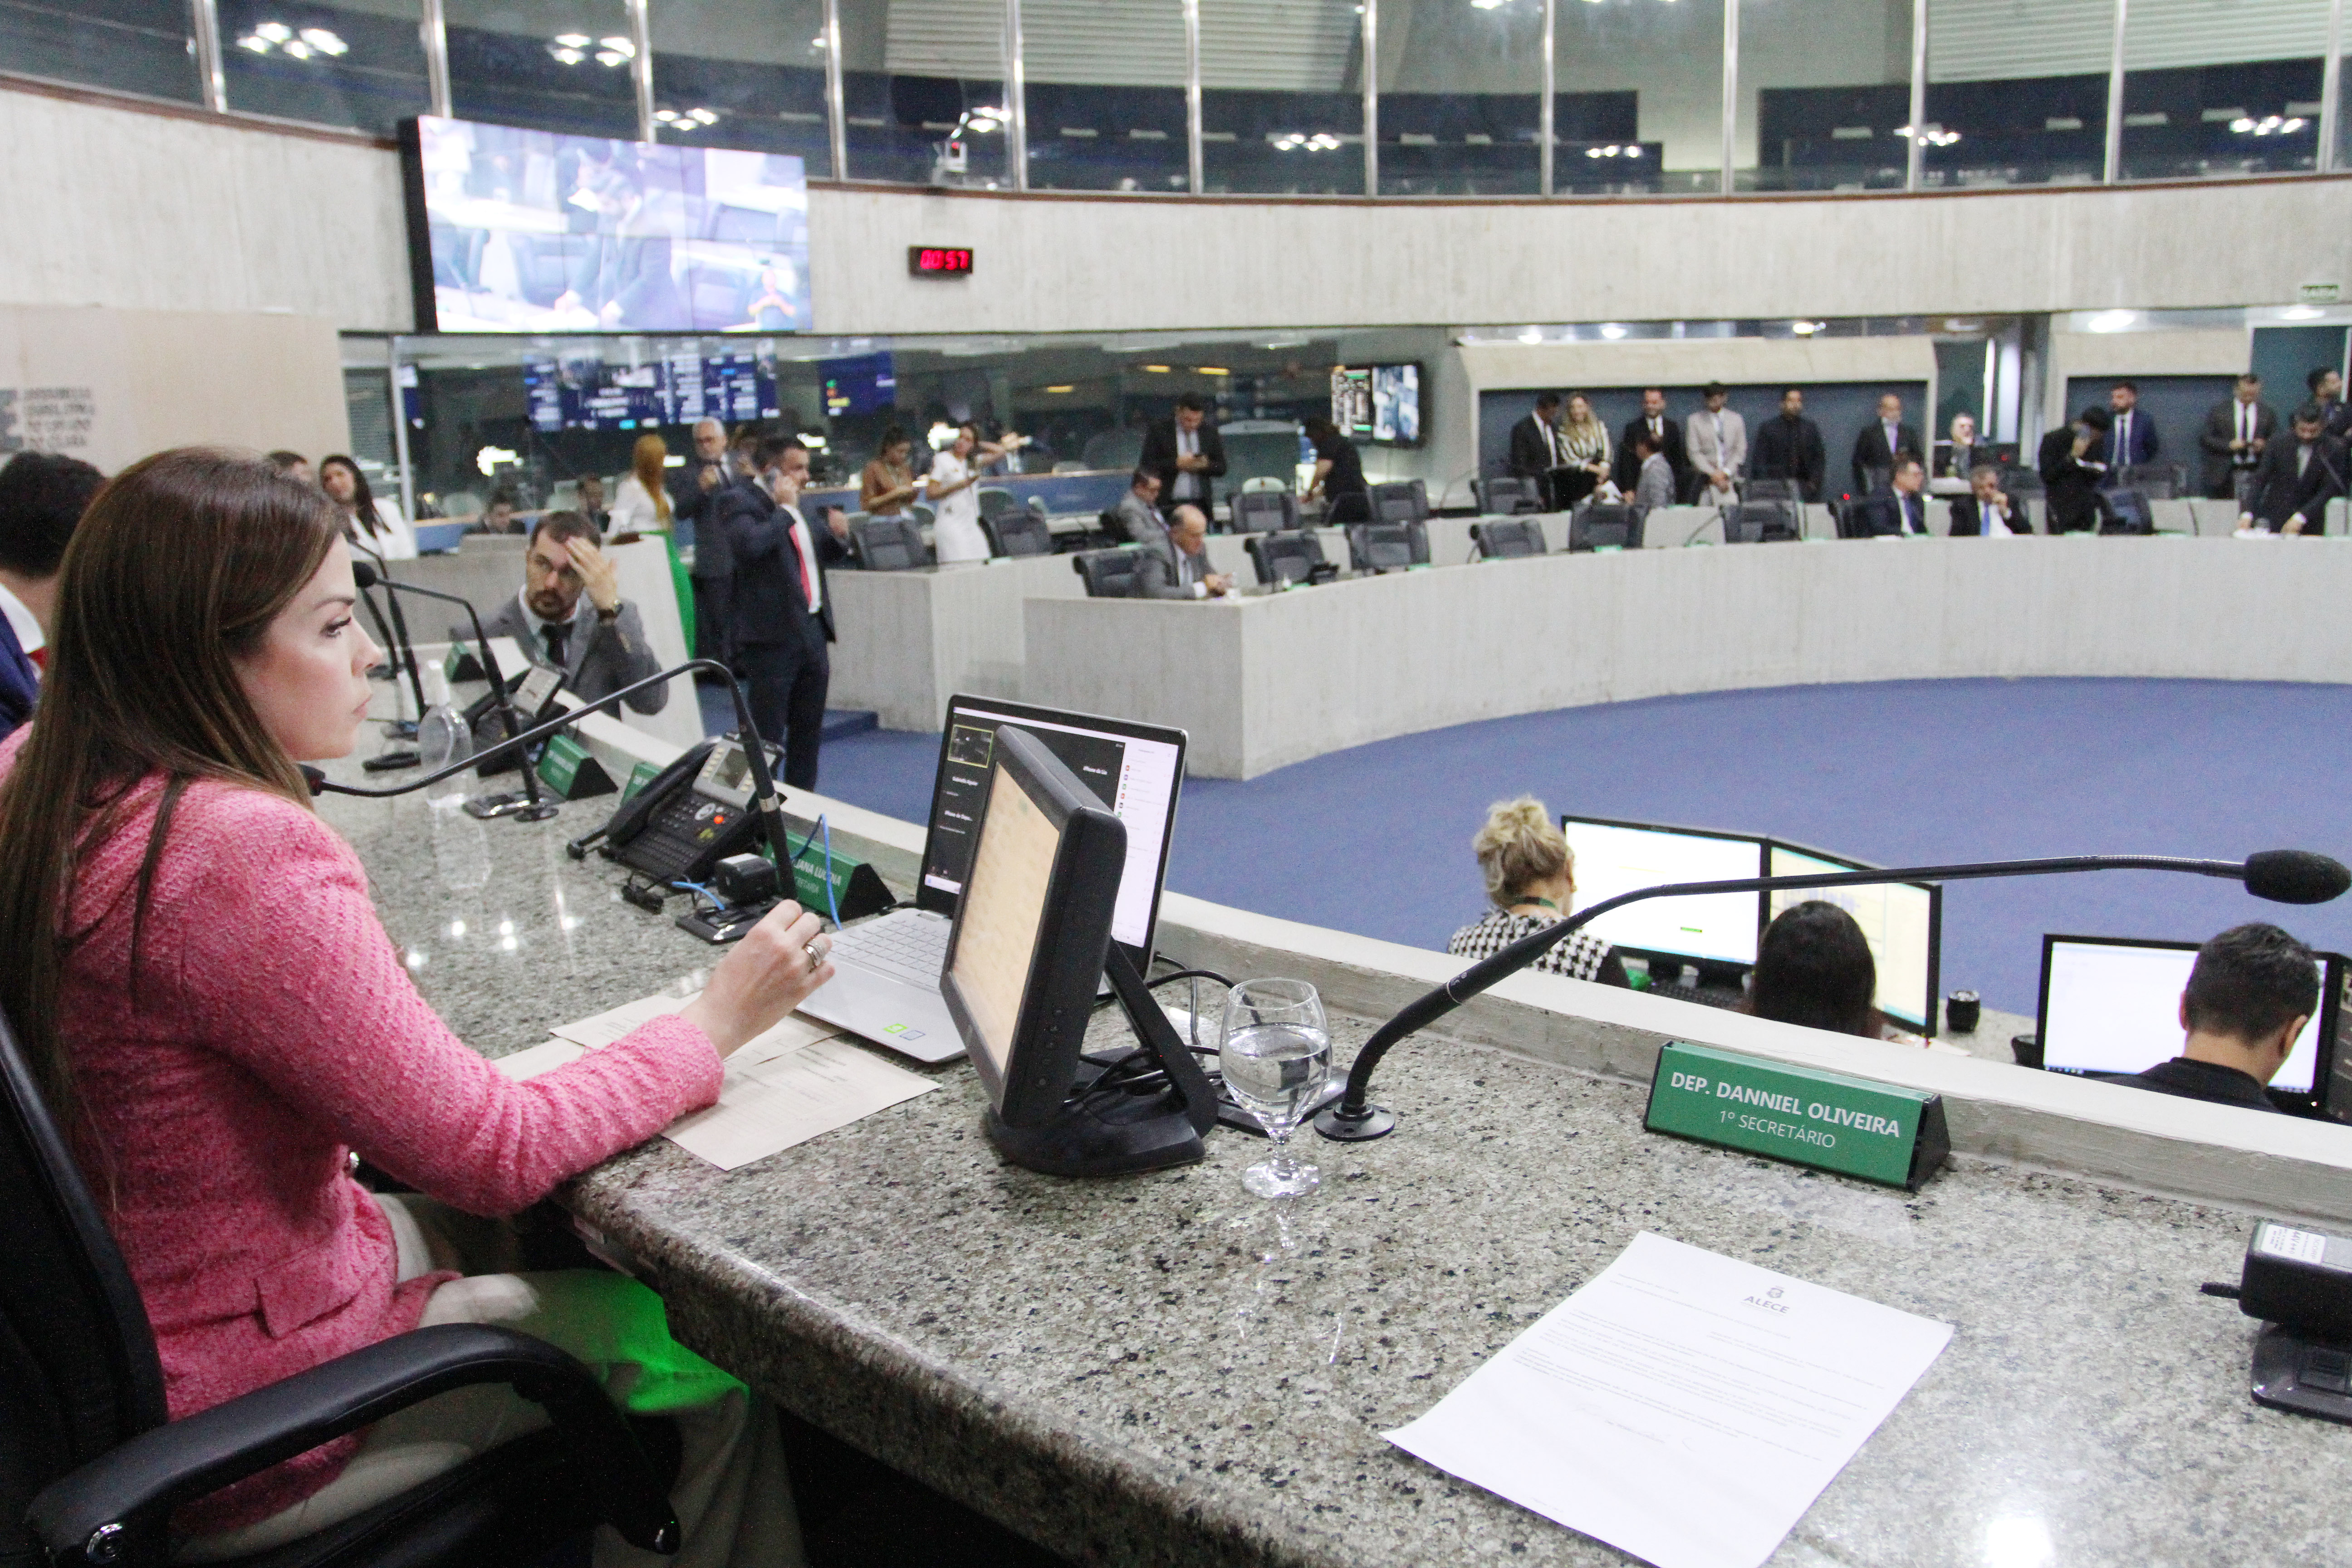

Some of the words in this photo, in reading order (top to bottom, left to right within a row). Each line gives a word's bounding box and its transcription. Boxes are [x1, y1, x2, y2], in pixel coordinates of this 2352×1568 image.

[1671, 1072, 1710, 1095] DEP.
[1716, 1082, 1802, 1116] DANNIEL
[1808, 1103, 1900, 1138] OLIVEIRA
[1738, 1115, 1836, 1148] SECRETÁRIO
[1744, 1296, 1790, 1313] ALECE
